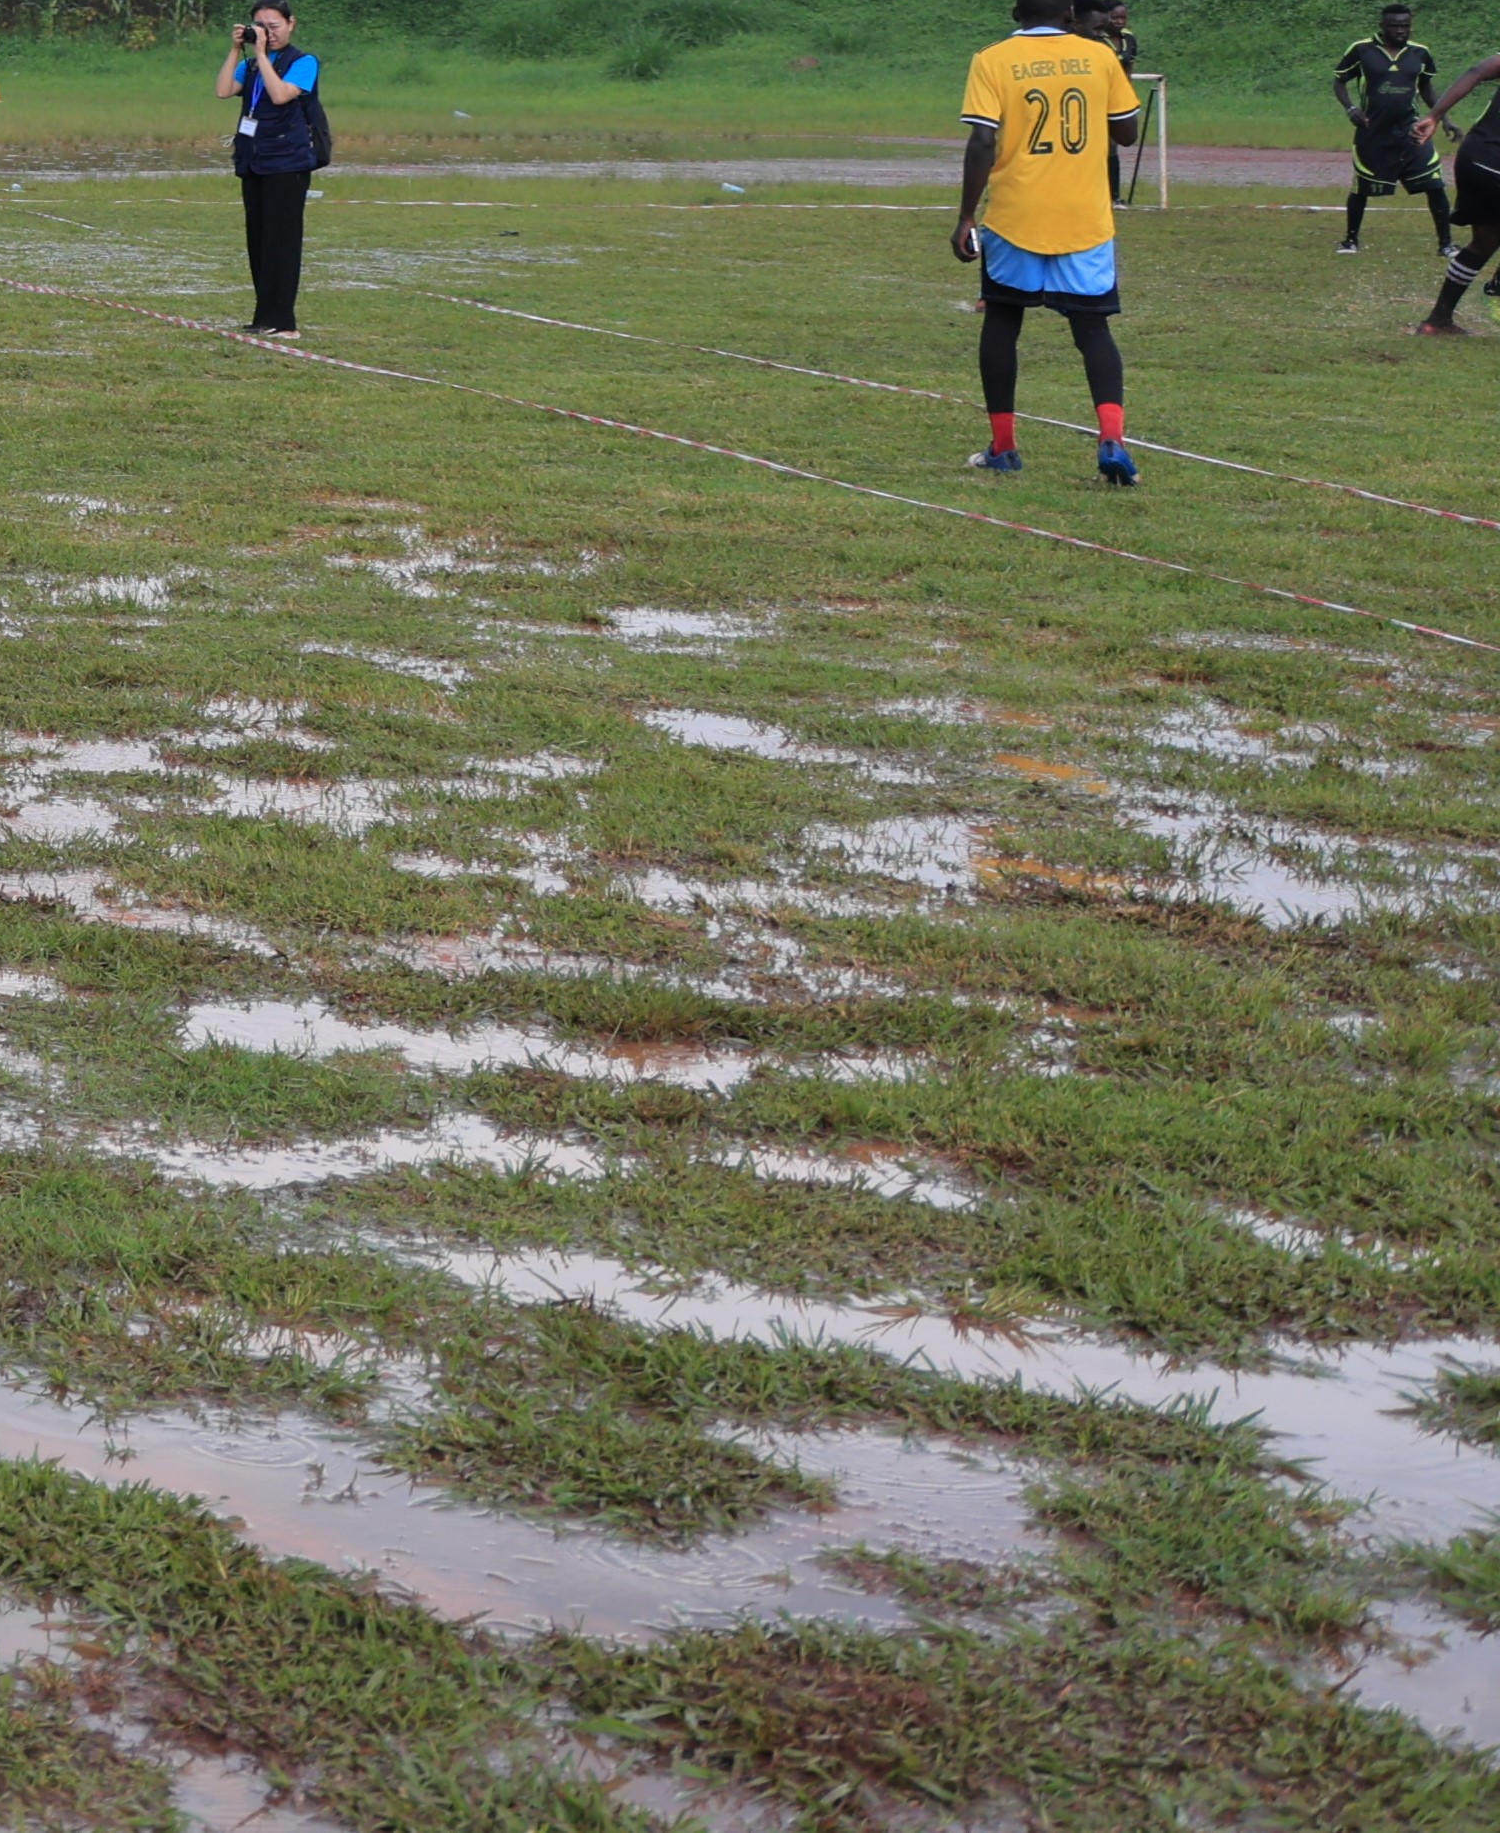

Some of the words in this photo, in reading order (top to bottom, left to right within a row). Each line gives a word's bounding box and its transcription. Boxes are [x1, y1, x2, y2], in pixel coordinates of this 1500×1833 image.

[1011, 60, 1056, 81] EAGER
[1060, 58, 1092, 75] DELE
[1024, 88, 1087, 155] 20
